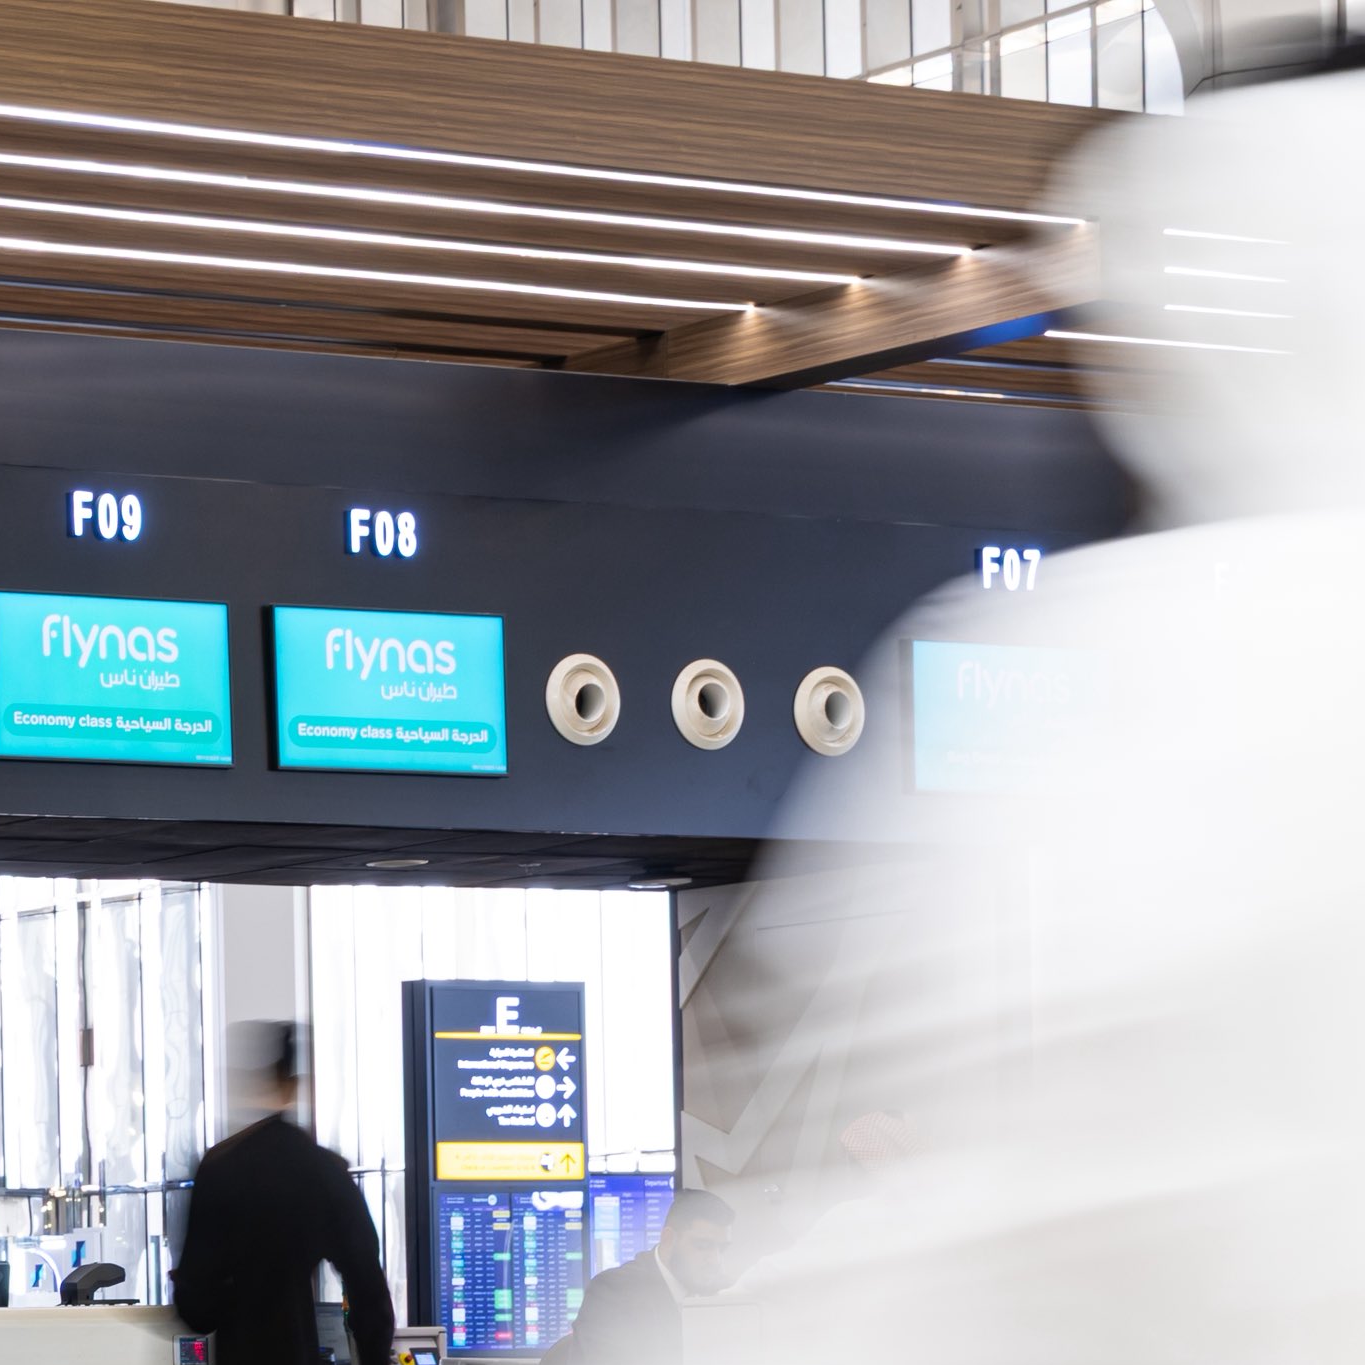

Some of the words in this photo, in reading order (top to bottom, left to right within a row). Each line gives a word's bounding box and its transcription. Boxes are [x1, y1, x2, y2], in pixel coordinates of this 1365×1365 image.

[70, 490, 143, 542] F09
[348, 508, 418, 557] F08
[981, 546, 1044, 591] F07
[42, 613, 179, 668] flynas
[325, 627, 456, 681] flynas
[13, 711, 75, 730] Economy
[79, 713, 112, 729] class
[117, 715, 171, 734] السياحية
[174, 718, 212, 736] الدرجة
[297, 722, 357, 741] Economy
[361, 724, 392, 740] class
[395, 726, 449, 744] السياحية
[451, 728, 488, 746] الدرجة
[496, 996, 520, 1033] E
